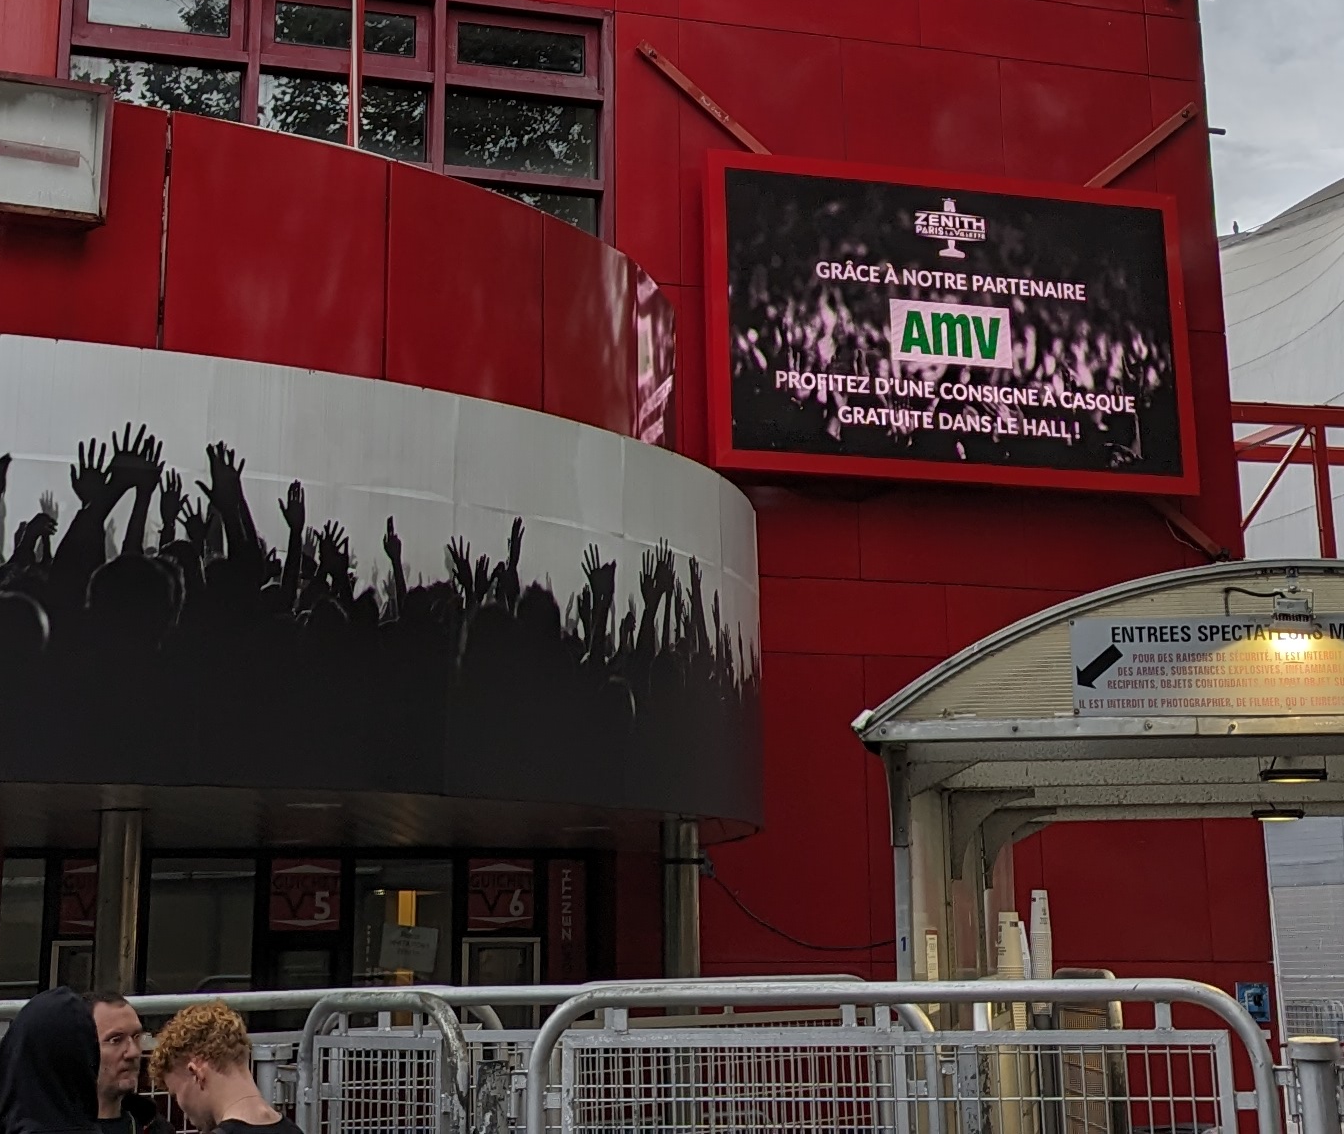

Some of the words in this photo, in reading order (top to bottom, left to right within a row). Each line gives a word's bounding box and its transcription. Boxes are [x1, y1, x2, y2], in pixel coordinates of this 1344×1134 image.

[914, 212, 986, 230] ZENITH
[916, 225, 944, 236] PARIS
[816, 260, 881, 283] GRÂCE
[884, 265, 899, 285] À
[902, 269, 968, 291] NOTRE
[972, 275, 1086, 301] PARTENAIRE
[775, 370, 870, 394] PROFITEZ
[875, 377, 936, 399] D'UNE
[940, 382, 1039, 407] CONSIGNE
[1042, 386, 1057, 407] À
[1060, 391, 1136, 413] CASQUE
[838, 405, 933, 429] GRATUITE
[939, 412, 992, 433] DANS
[996, 416, 1018, 435] LE
[1111, 624, 1192, 643] ENTREES
[1132, 653, 1156, 663] POUR
[1158, 653, 1174, 663] DES
[1176, 652, 1214, 663] RAISONS
[1216, 652, 1227, 662] DE
[1285, 651, 1301, 661] EST
[1304, 650, 1343, 661] INTERDIT
[1117, 667, 1134, 677] DES
[1136, 666, 1169, 677] ARMES,
[1171, 665, 1226, 676] SUBSTANCES
[1228, 664, 1283, 675] EXPLOSIVES,
[1160, 678, 1192, 689] OBJETS
[1264, 677, 1276, 688] OU
[1278, 677, 1301, 687] TOUT
[1303, 676, 1330, 687] OBJET
[1079, 699, 1086, 709] IL
[1089, 698, 1105, 709] EST
[1107, 698, 1146, 709] INTERDIT
[1148, 698, 1158, 708] DE
[1236, 697, 1247, 708] DE
[1285, 696, 1297, 707] OU
[313, 890, 331, 920] 5
[509, 888, 525, 917] 6
[561, 868, 572, 941] ZENITH
[900, 936, 907, 952] 1
